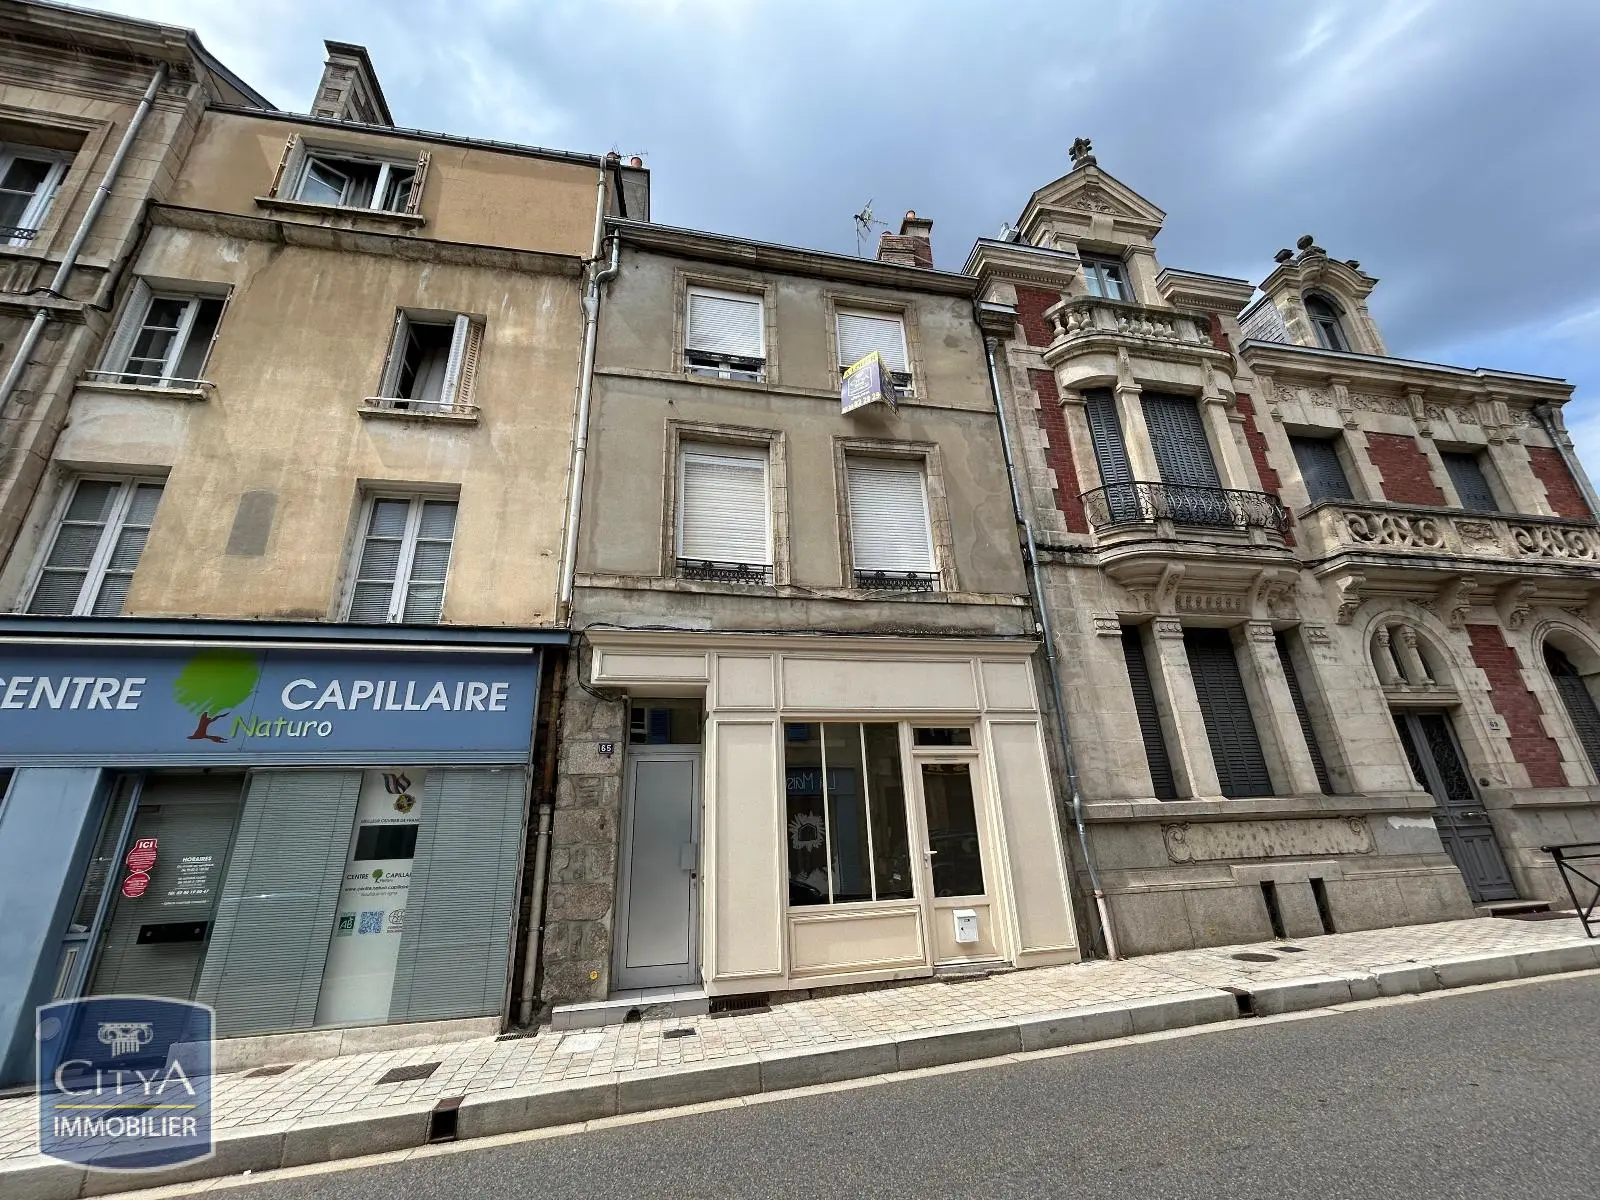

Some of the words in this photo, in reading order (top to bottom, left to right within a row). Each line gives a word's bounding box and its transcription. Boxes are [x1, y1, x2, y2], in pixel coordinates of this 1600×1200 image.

[0, 676, 147, 711] ENTRE
[281, 678, 509, 712] CAPILLAIRE
[230, 714, 332, 738] Naturo
[601, 744, 612, 752] 65
[139, 841, 154, 849] ICI
[340, 919, 354, 929] AB
